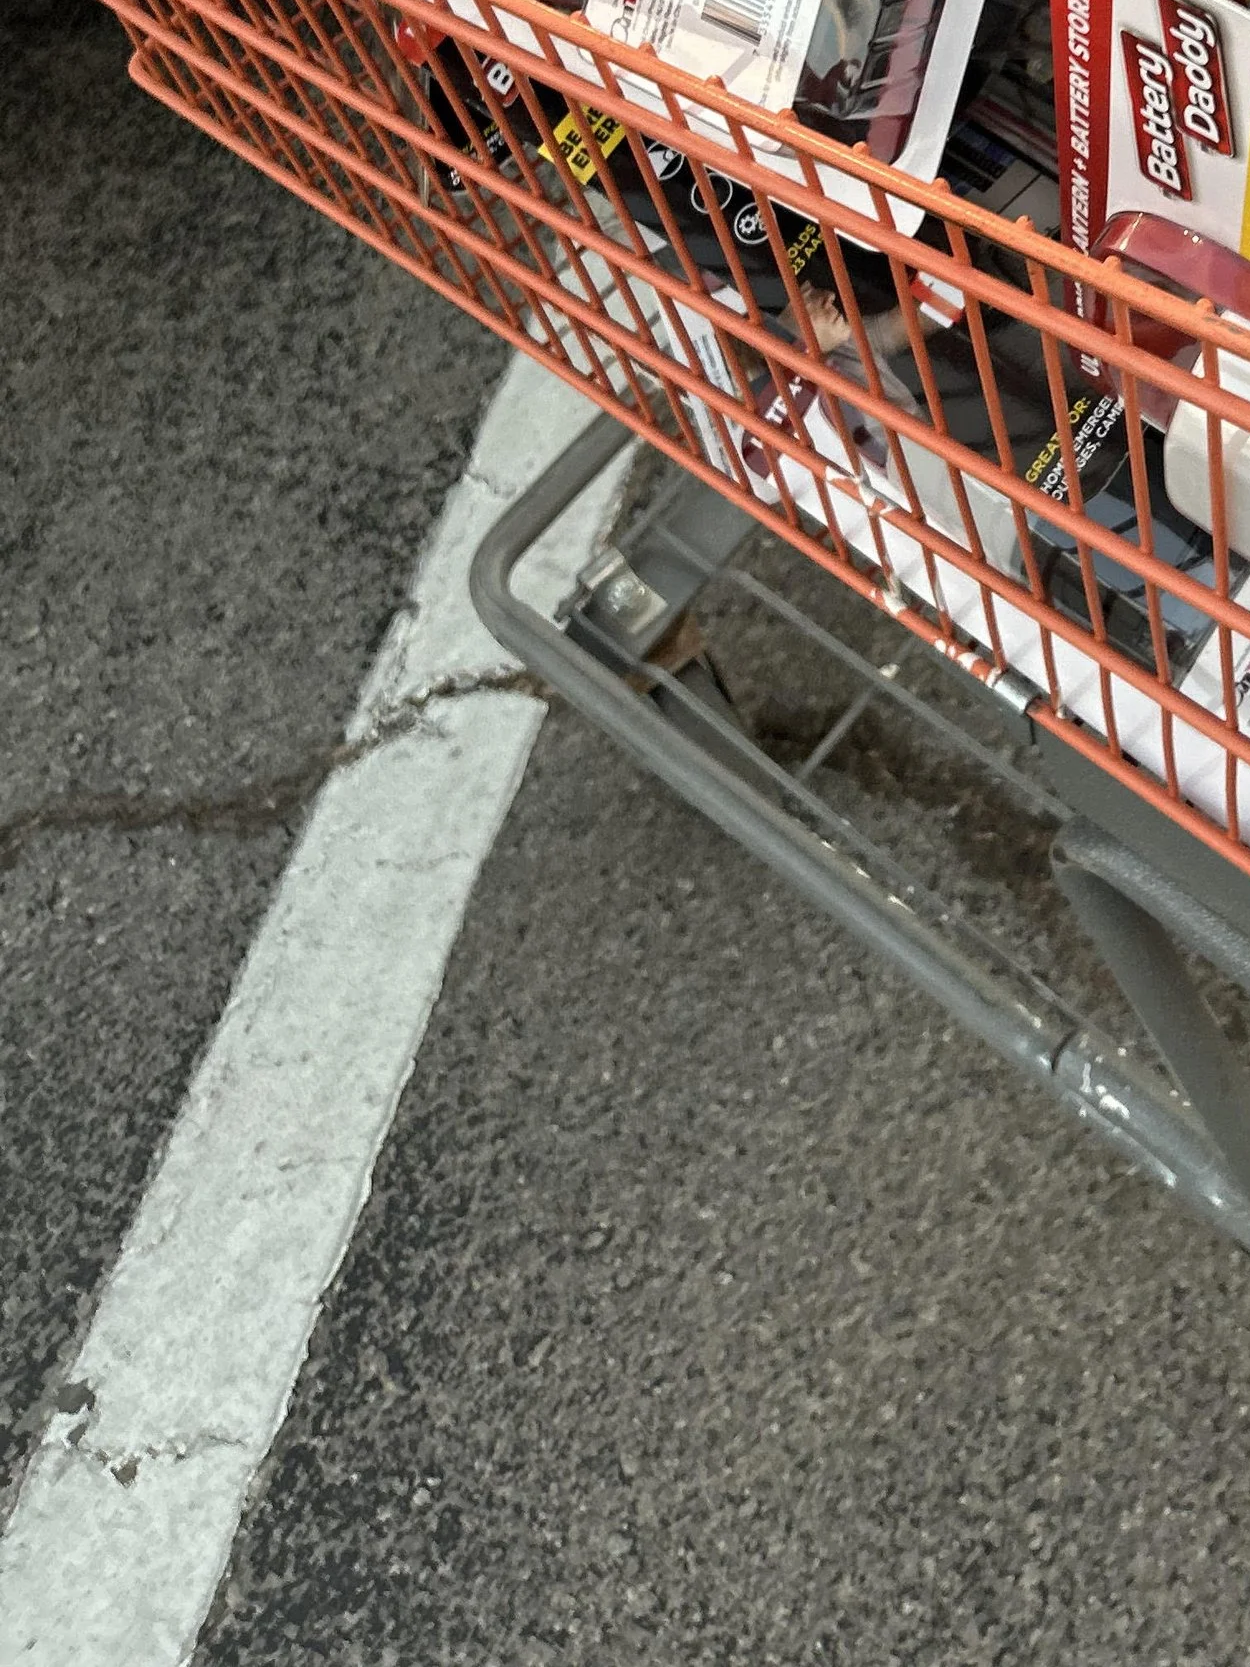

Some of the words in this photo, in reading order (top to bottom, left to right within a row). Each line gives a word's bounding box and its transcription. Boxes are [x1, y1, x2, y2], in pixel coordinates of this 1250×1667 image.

[1073, 60, 1091, 155] BATTERY
[1139, 44, 1180, 190] Battery
[1176, 8, 1218, 142] Daddy
[788, 224, 816, 259] OLDS
[1074, 169, 1089, 253] ANTERN
[1068, 396, 1092, 424] OR:
